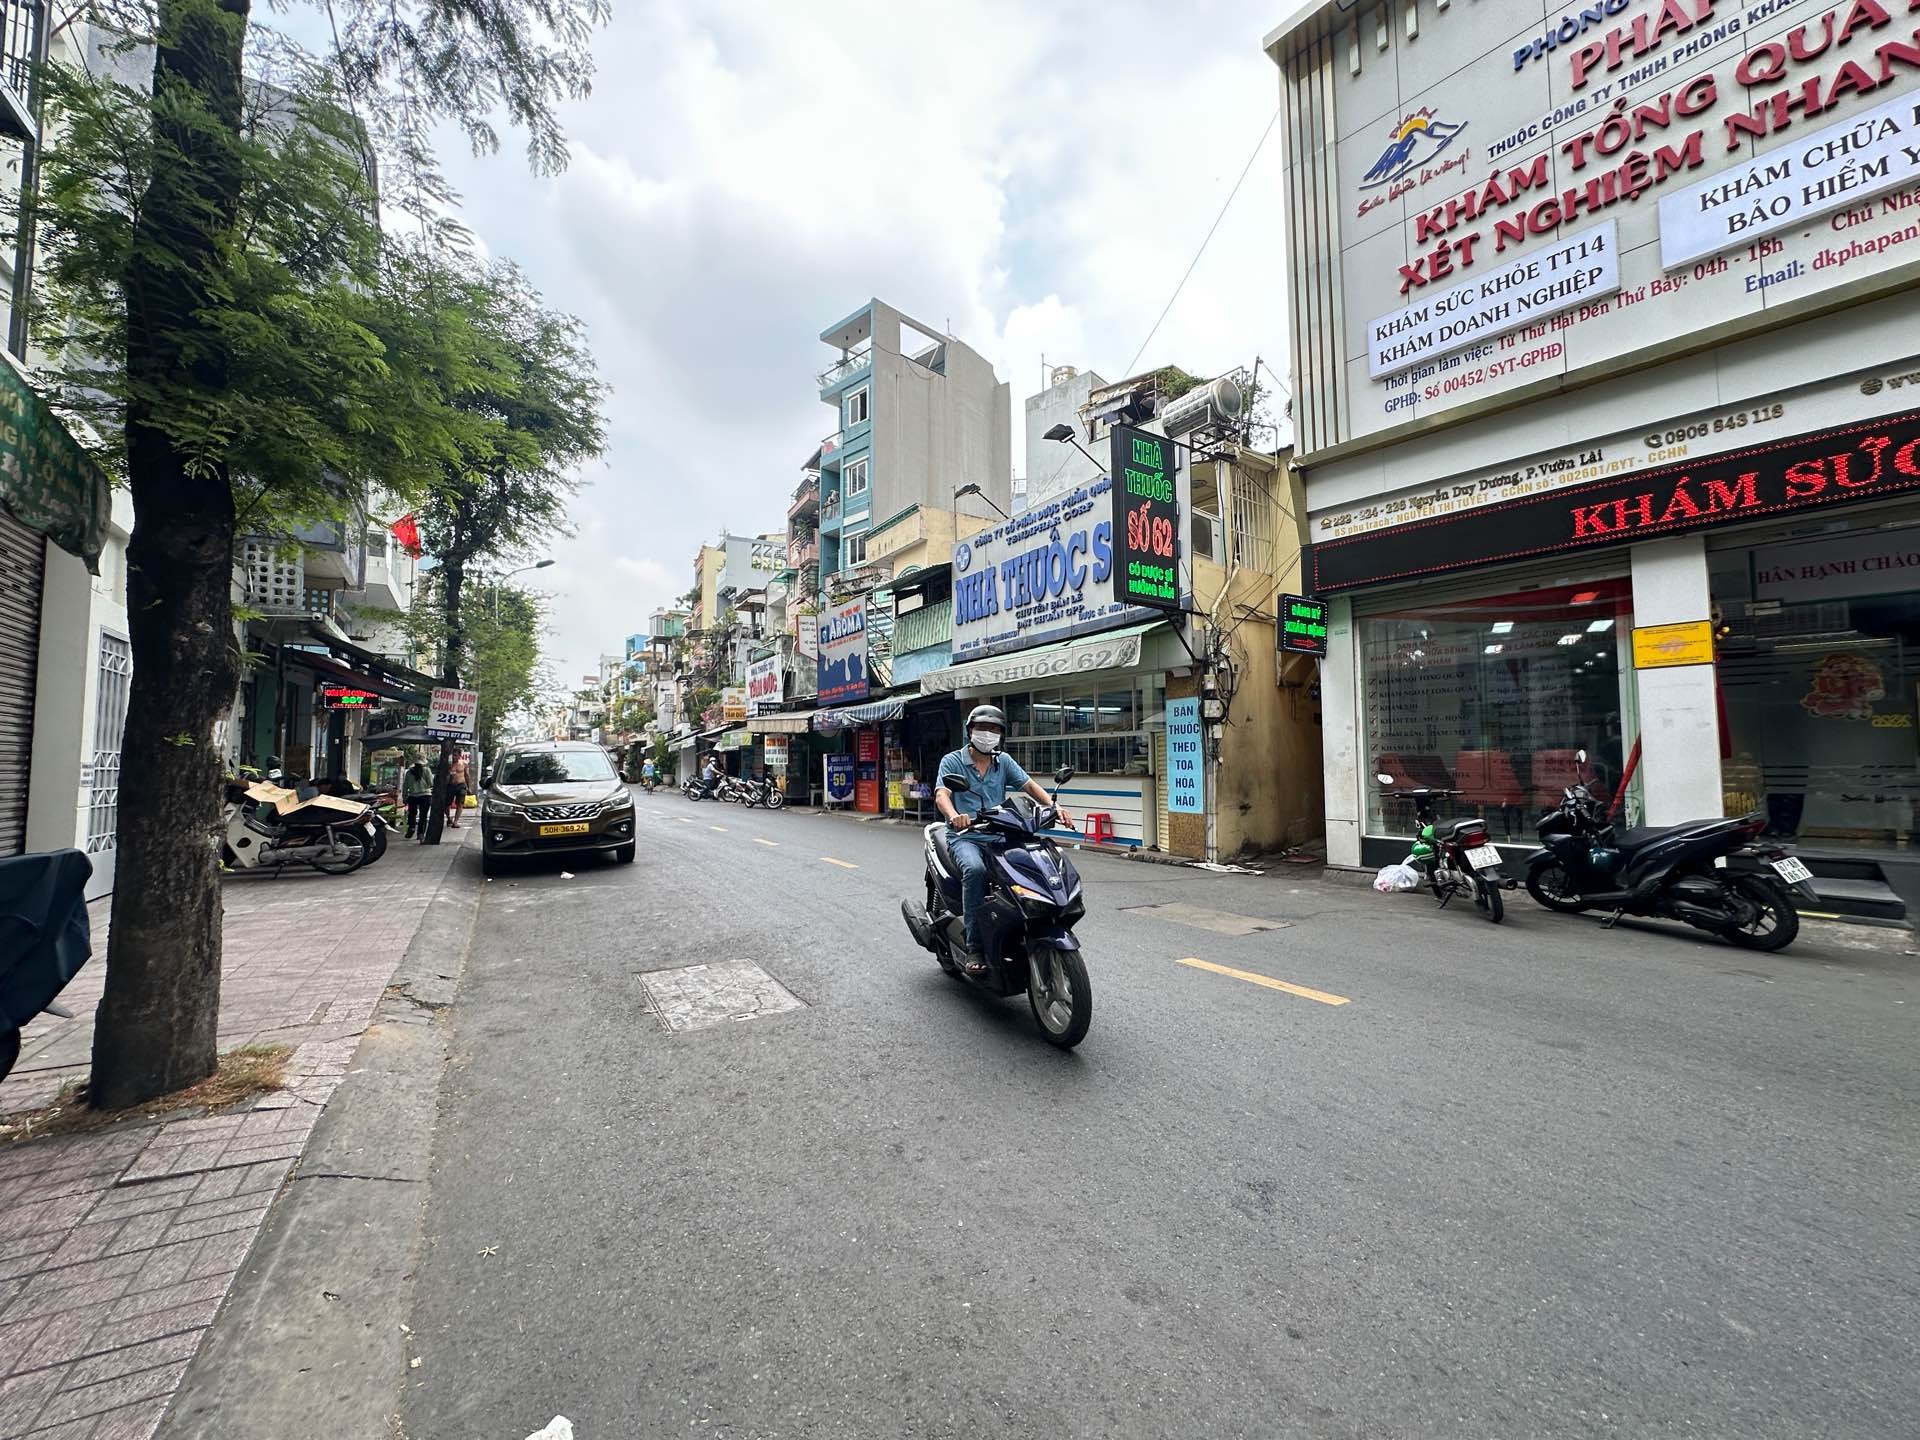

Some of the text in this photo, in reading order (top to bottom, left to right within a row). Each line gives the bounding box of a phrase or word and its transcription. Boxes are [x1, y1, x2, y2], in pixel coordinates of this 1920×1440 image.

[1487, 124, 1537, 158] THUỘC
[1542, 98, 1586, 131] CÔNG
[1591, 84, 1612, 106] TY
[1618, 56, 1667, 91] TNHH
[1673, 18, 1741, 65] PHÒNG
[1415, 153, 1549, 244] KHÁM
[1562, 73, 1717, 171] TỔNG
[1700, 117, 1901, 211] KHÁM CHỮA
[1398, 232, 1480, 294] XÉT
[1494, 129, 1704, 252] NGHIỆM
[1728, 195, 1791, 234] BẢO
[1801, 155, 1889, 206] HIỂM
[1745, 219, 1920, 294] Email: dkphapan
[1376, 234, 1606, 341] KHÁM SỨC KHỎE TT14
[1384, 373, 1408, 391] Thời
[1411, 367, 1435, 385] gian
[1438, 355, 1460, 373] làm
[1464, 343, 1493, 363] việc:
[1497, 334, 1516, 351] Từ
[1519, 320, 1546, 343] Thứ
[1551, 310, 1575, 331] Hai
[1579, 303, 1609, 322] Đến
[1614, 288, 1645, 310] Thứ
[1651, 274, 1688, 297] Bảy:
[1694, 257, 1728, 280] 04h
[1749, 238, 1784, 262] 18h
[1831, 203, 1873, 231] Chủ
[1379, 266, 1603, 365] KHÁM DOANH NGHIỆP
[1384, 342, 1563, 413] GPHĐ: Số 00452/SYT-GPHĐ
[1133, 438, 1162, 470] NHÀ
[1501, 482, 1533, 498] CCHN
[1648, 444, 1688, 464] CCHN
[1125, 468, 1172, 503] THUỐC
[1409, 487, 1449, 509] Nguyễn
[1453, 483, 1476, 497] Duy
[1063, 501, 1094, 521] CORP
[1571, 472, 1761, 538] KHÁM
[1128, 500, 1173, 557] SỐ 62
[1800, 560, 1857, 580] HẠNH
[955, 560, 998, 626] NHÀ
[1050, 597, 1070, 611] BÁN
[830, 613, 863, 641] AROMA
[947, 649, 1112, 690] NHÀ THUỐC 62
[434, 689, 455, 701] CƠM
[1173, 703, 1194, 717] BÁN
[436, 713, 468, 725] 287
[1169, 719, 1200, 735] THUỐC
[1173, 741, 1196, 753] THEO
[1176, 759, 1194, 771] TOA
[833, 773, 846, 786] 59
[1176, 792, 1195, 807] HẢO
